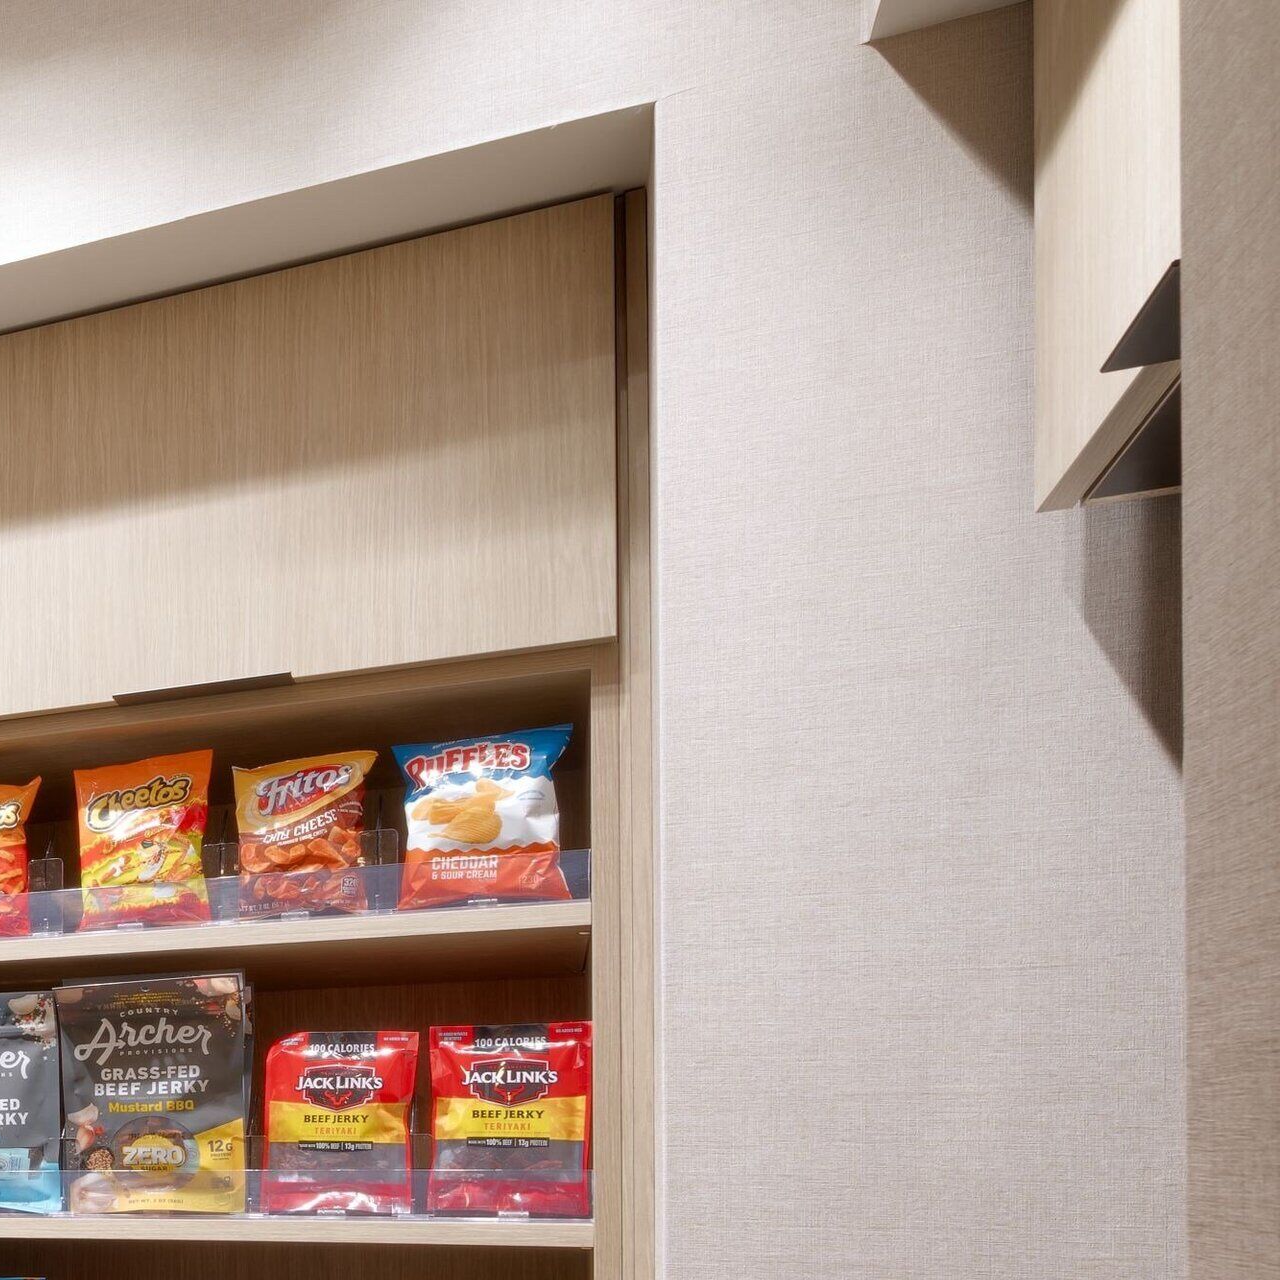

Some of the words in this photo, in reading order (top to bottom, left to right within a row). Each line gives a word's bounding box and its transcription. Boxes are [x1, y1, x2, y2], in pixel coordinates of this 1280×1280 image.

[405, 742, 531, 793] RUFFLES
[256, 763, 353, 816] Fritos
[88, 776, 191, 831] Cheetos
[432, 854, 498, 871] CHEDDAR
[441, 870, 463, 879] SOUR
[466, 869, 497, 879] CREAM
[120, 1007, 179, 1018] COUNTRY
[74, 1018, 212, 1065] Archer
[120, 1048, 193, 1057] PROVISIONS
[101, 1064, 201, 1081] GRASS-FED
[462, 1069, 504, 1085] JACK
[506, 1069, 558, 1085] LINK'S
[94, 1082, 140, 1097] BEEF
[146, 1079, 209, 1095] JERKY
[108, 1101, 163, 1114] Mustard
[166, 1100, 195, 1113] BBQ
[472, 1110, 502, 1119] BEEF
[504, 1110, 545, 1119] JERKY
[304, 1115, 330, 1124] BEEF
[332, 1114, 369, 1124] JERKY
[484, 1122, 530, 1131] TERIYAKI
[315, 1127, 357, 1136] TERIYAKI
[122, 1145, 187, 1168] ZERO
